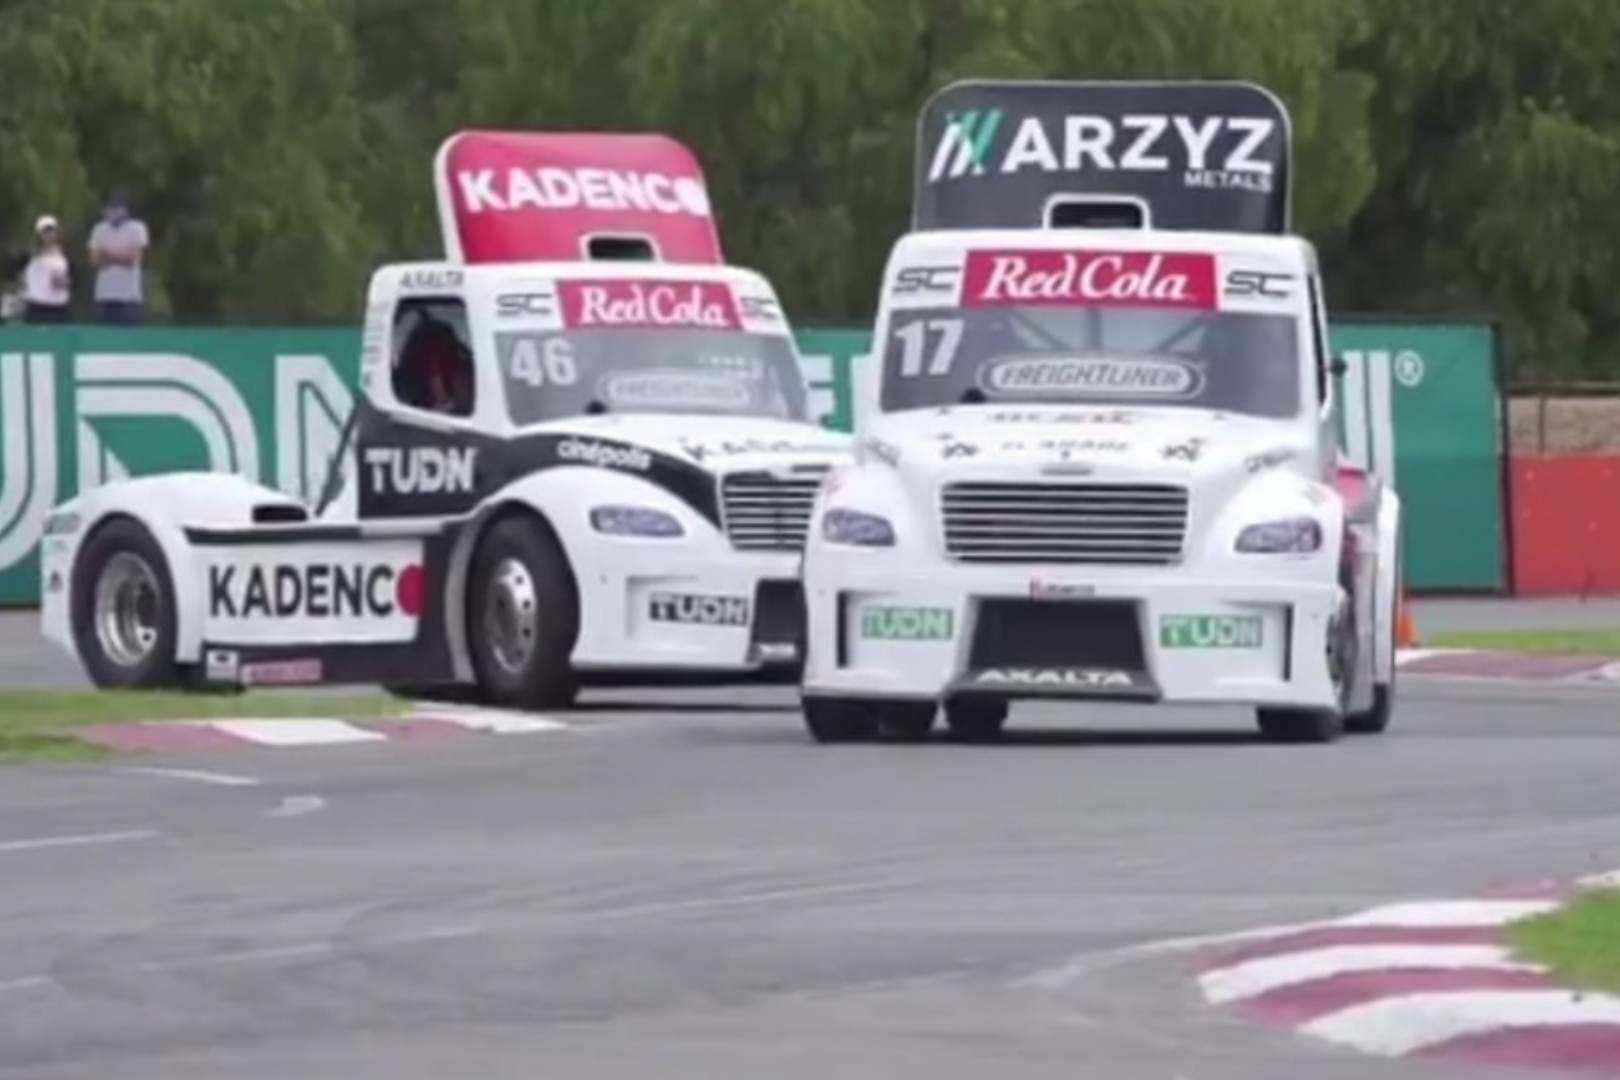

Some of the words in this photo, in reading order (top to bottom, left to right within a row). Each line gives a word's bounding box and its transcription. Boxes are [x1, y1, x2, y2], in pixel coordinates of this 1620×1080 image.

[1002, 116, 1275, 173] ARZYZ
[1184, 170, 1274, 193] METALS
[509, 339, 577, 388] 46
[894, 319, 963, 377] 17
[1001, 362, 1183, 388] FREIGHTLINER
[366, 446, 477, 495] TUDN
[651, 594, 748, 626] TUDN
[862, 608, 952, 639] TUDN
[1161, 616, 1262, 647] TUDN
[976, 668, 1132, 686] AXALTA
